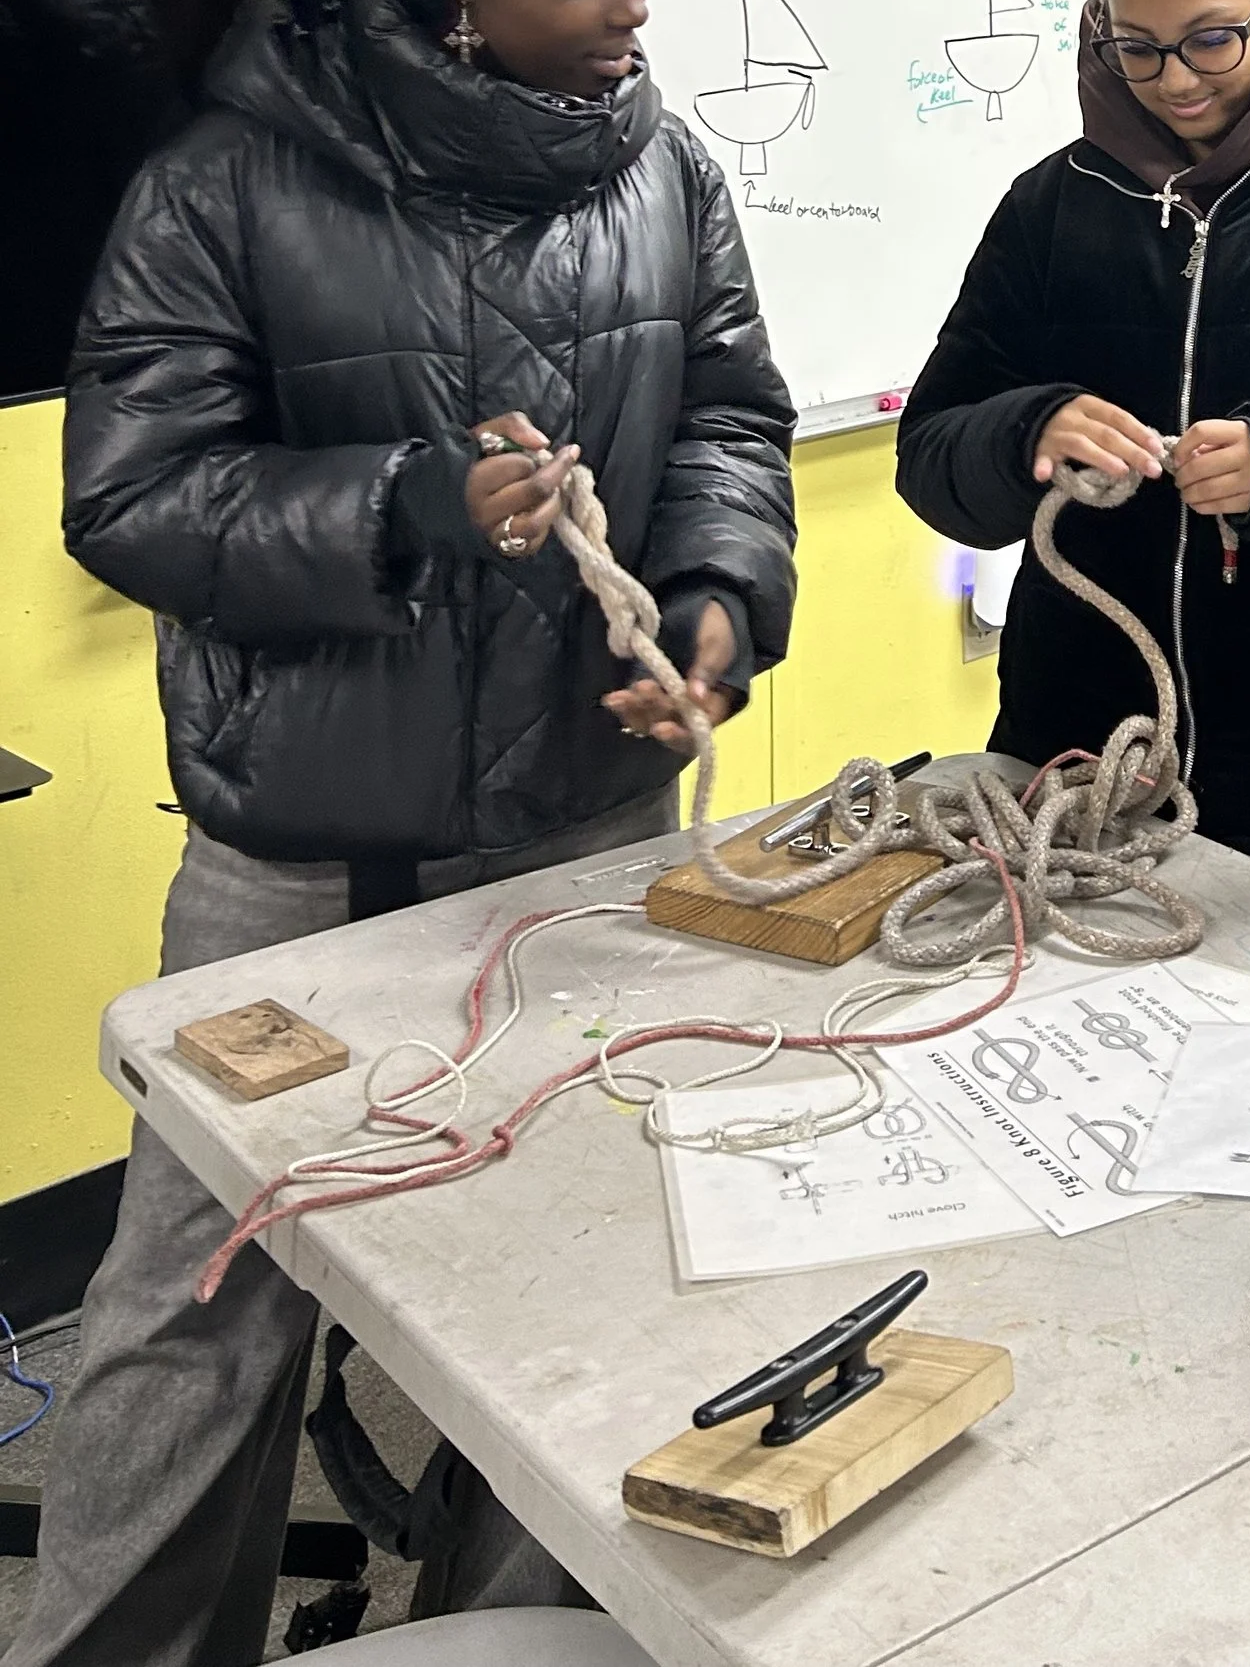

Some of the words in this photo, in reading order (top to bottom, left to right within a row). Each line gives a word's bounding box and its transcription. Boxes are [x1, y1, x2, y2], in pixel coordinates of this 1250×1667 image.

[1054, 17, 1067, 32] of
[1118, 988, 1140, 1006] knot
[1016, 1015, 1036, 1029] end
[1034, 1028, 1051, 1042] the
[1054, 1030, 1088, 1057] through
[1048, 1041, 1072, 1058] pass
[1067, 1057, 1088, 1074] Now
[927, 1051, 1000, 1119] Instructions
[1122, 1103, 1146, 1121] with
[995, 1117, 1031, 1148] Knot
[1022, 1147, 1041, 1159] 8
[1038, 1157, 1085, 1198] Figure
[888, 1208, 924, 1222] hitch
[928, 1202, 967, 1215] Clove
